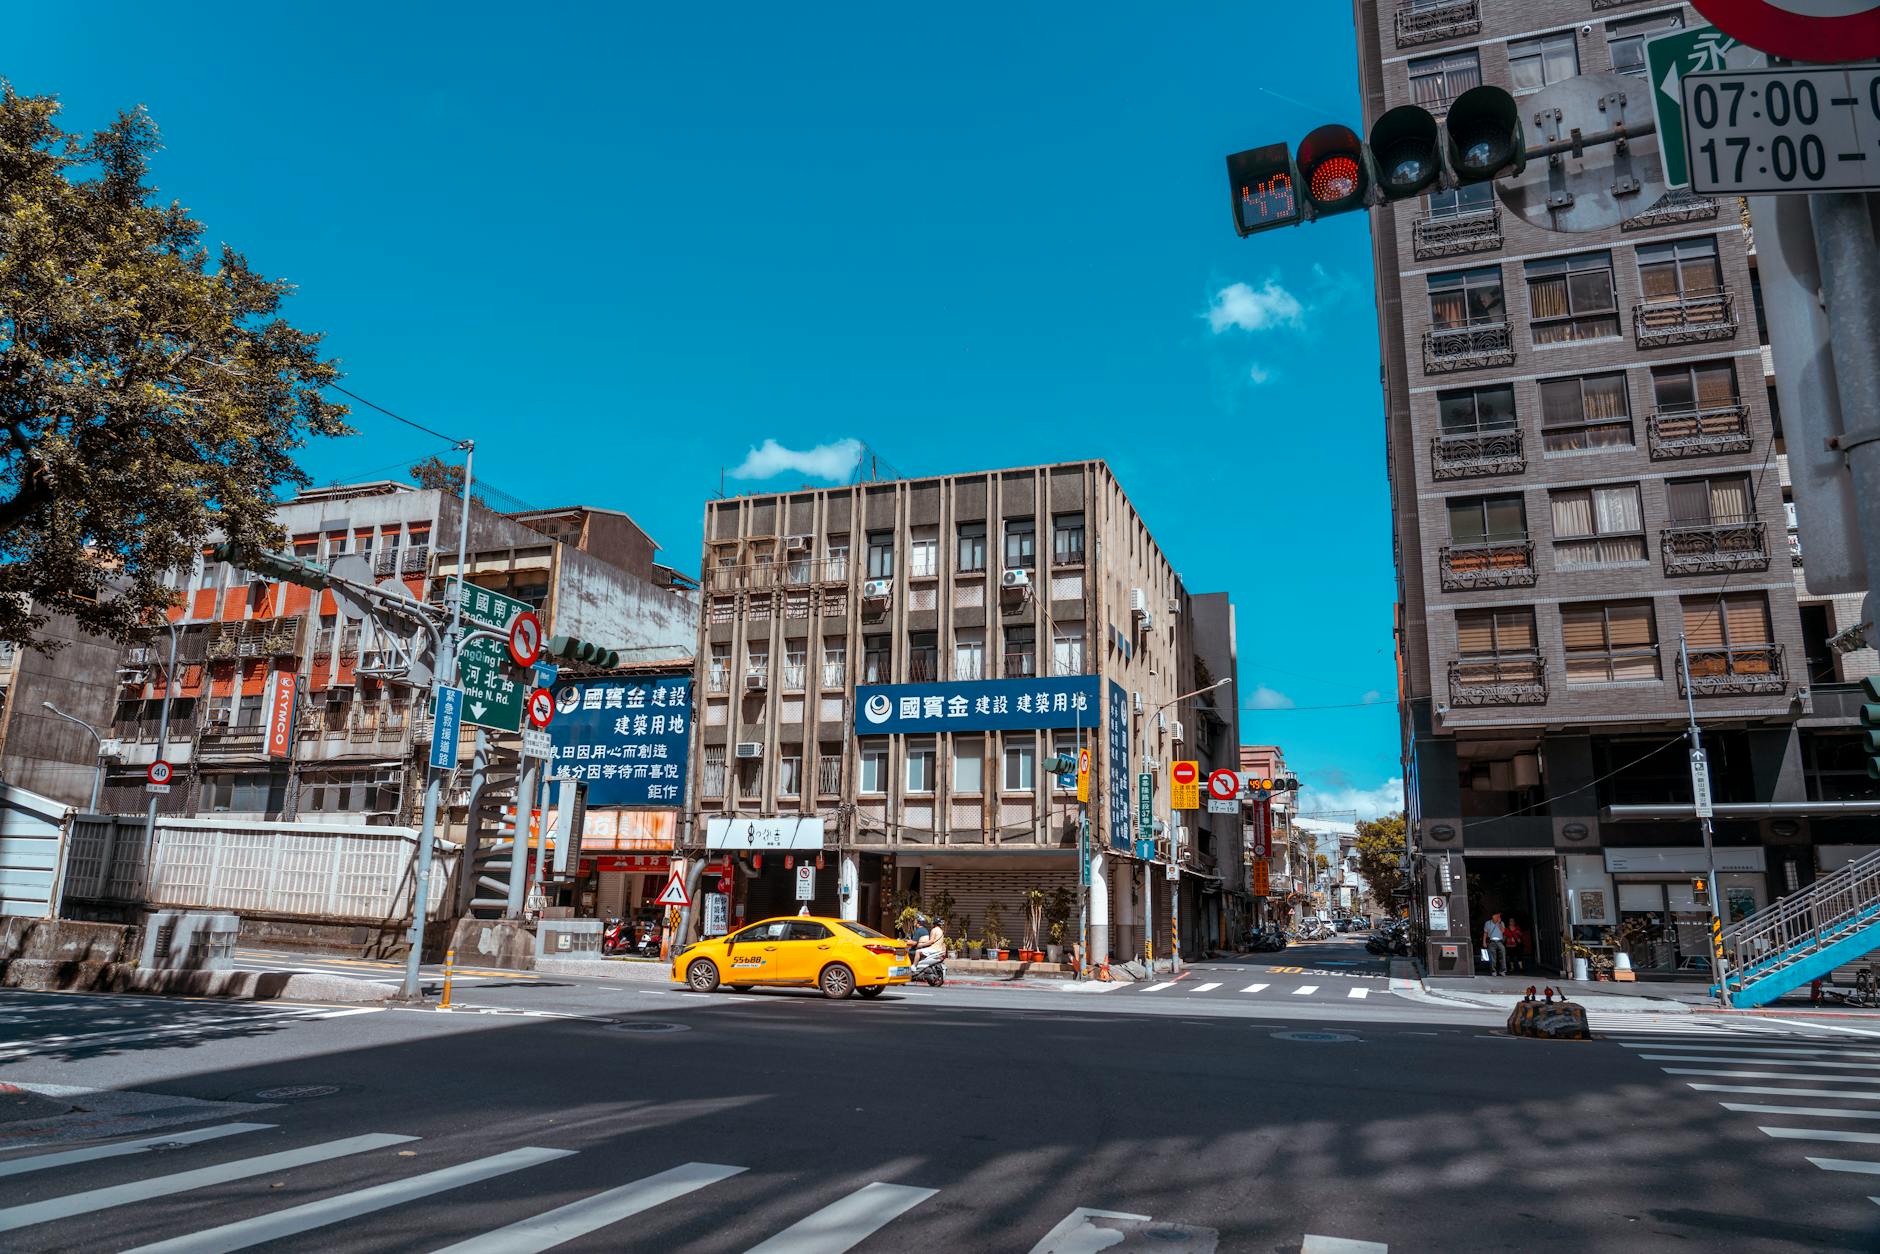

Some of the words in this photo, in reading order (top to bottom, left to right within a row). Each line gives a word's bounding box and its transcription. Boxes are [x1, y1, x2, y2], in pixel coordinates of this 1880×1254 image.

[1693, 79, 1819, 130] 07:00
[1699, 133, 1826, 184] 17:00
[1242, 172, 1294, 218] 49
[496, 692, 510, 705] Rd.
[275, 689, 290, 745] KYMCO
[614, 713, 685, 737] 建築用地
[438, 689, 456, 767] 緊急救援道路
[549, 743, 668, 760] 良田因用心而創造
[154, 768, 167, 778] 40
[556, 763, 680, 780] 緣分因等待而喜悅
[646, 783, 679, 800] 鉅作
[1249, 780, 1260, 790] 49
[733, 956, 761, 964] 55688
